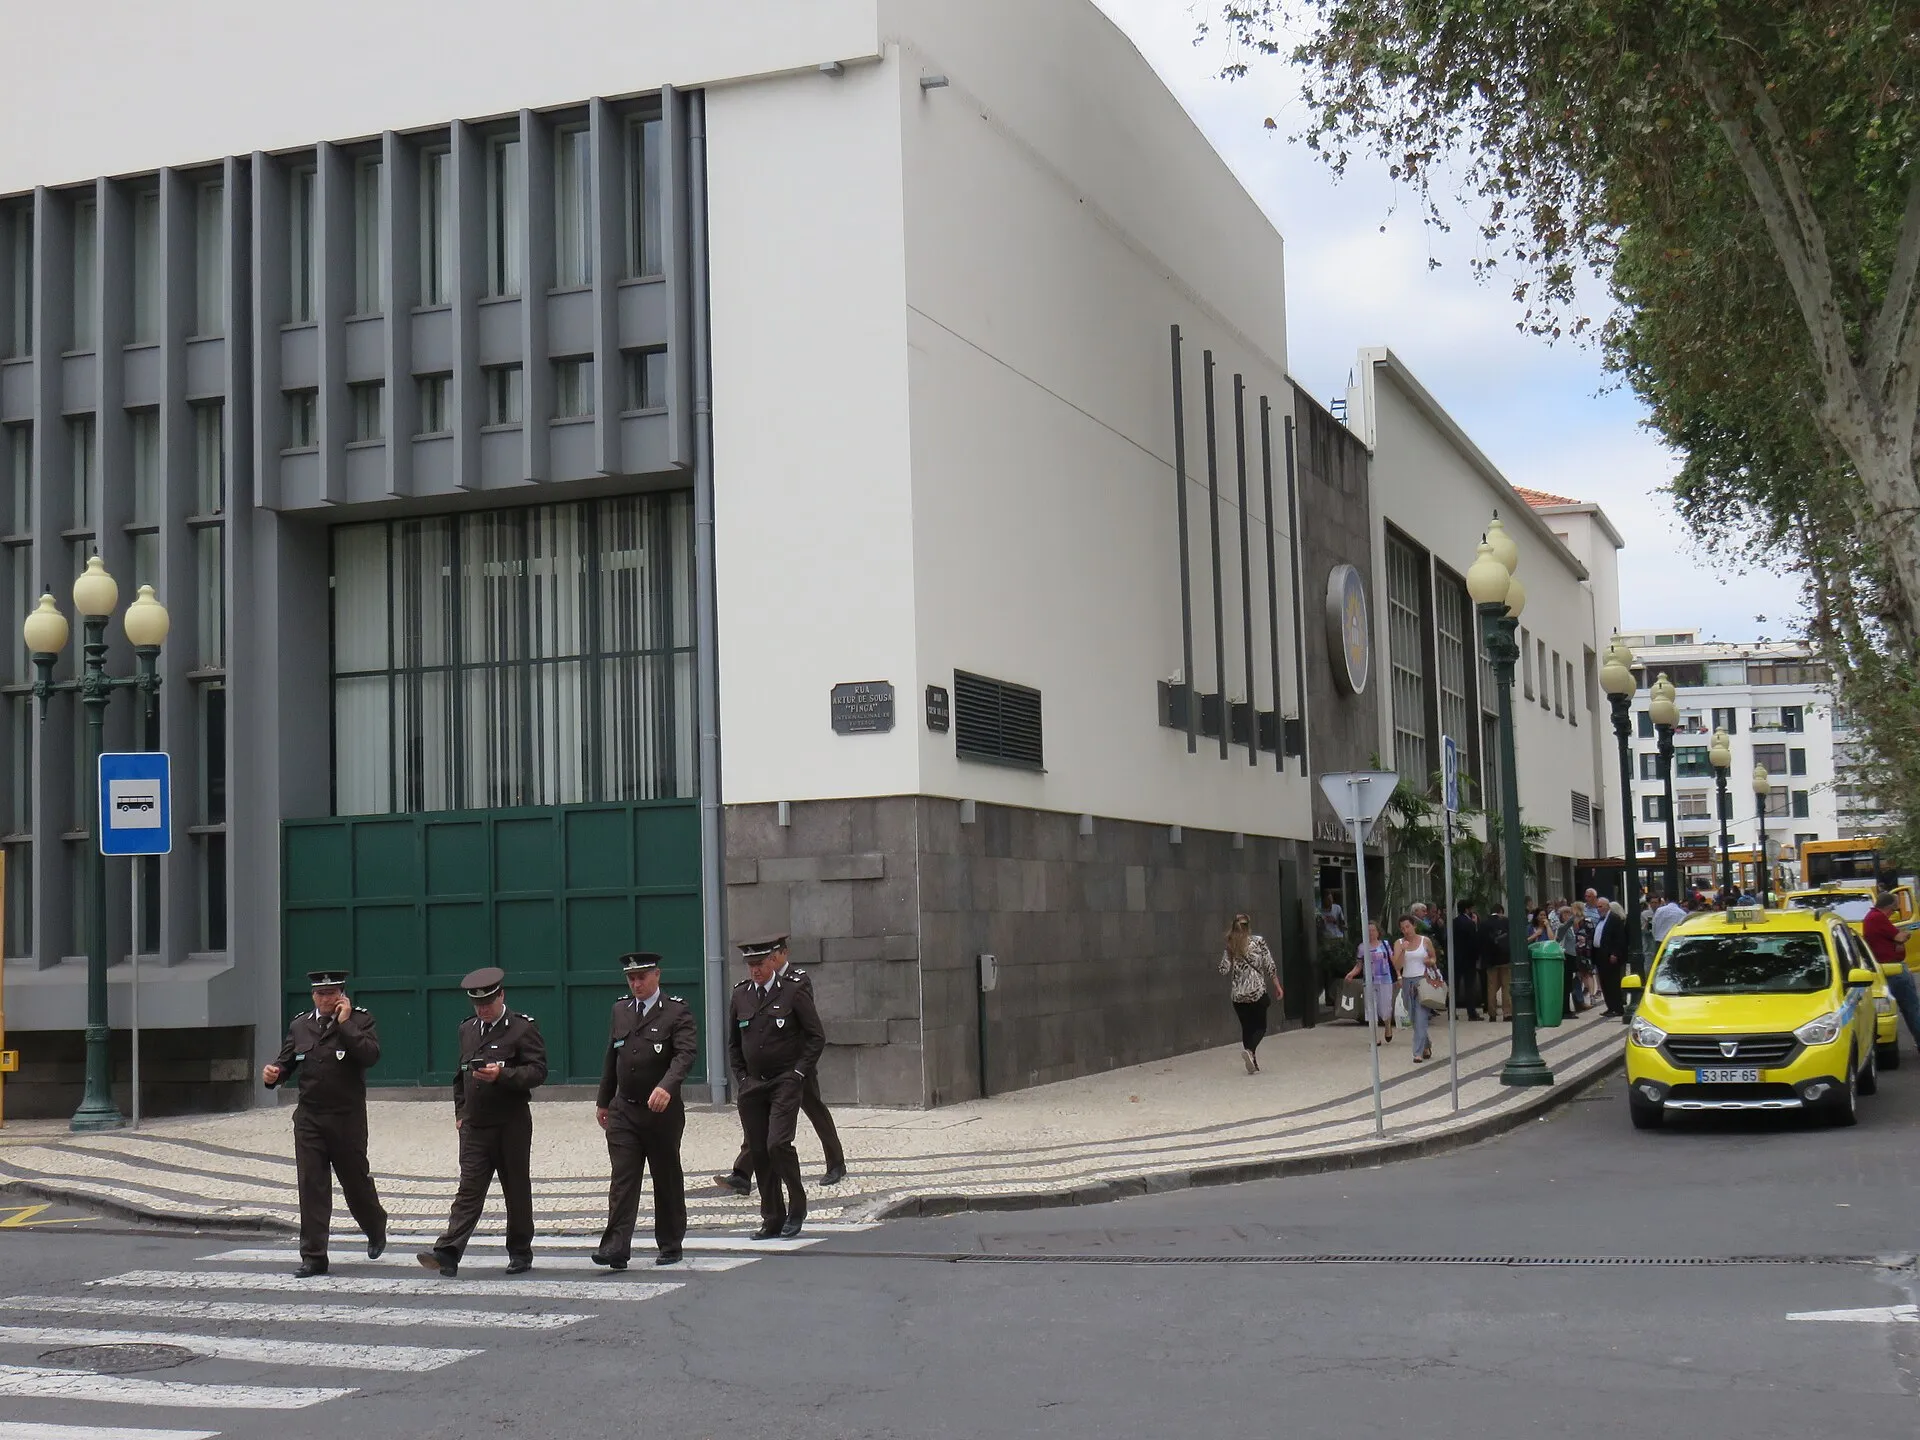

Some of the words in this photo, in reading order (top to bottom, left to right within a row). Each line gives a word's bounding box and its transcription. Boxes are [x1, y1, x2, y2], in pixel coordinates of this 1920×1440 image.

[854, 685, 870, 694] RUA
[832, 695, 856, 705] ARTUR
[858, 694, 867, 703] DE
[869, 693, 892, 703] SOUSA
[1734, 911, 1752, 919] TAXI
